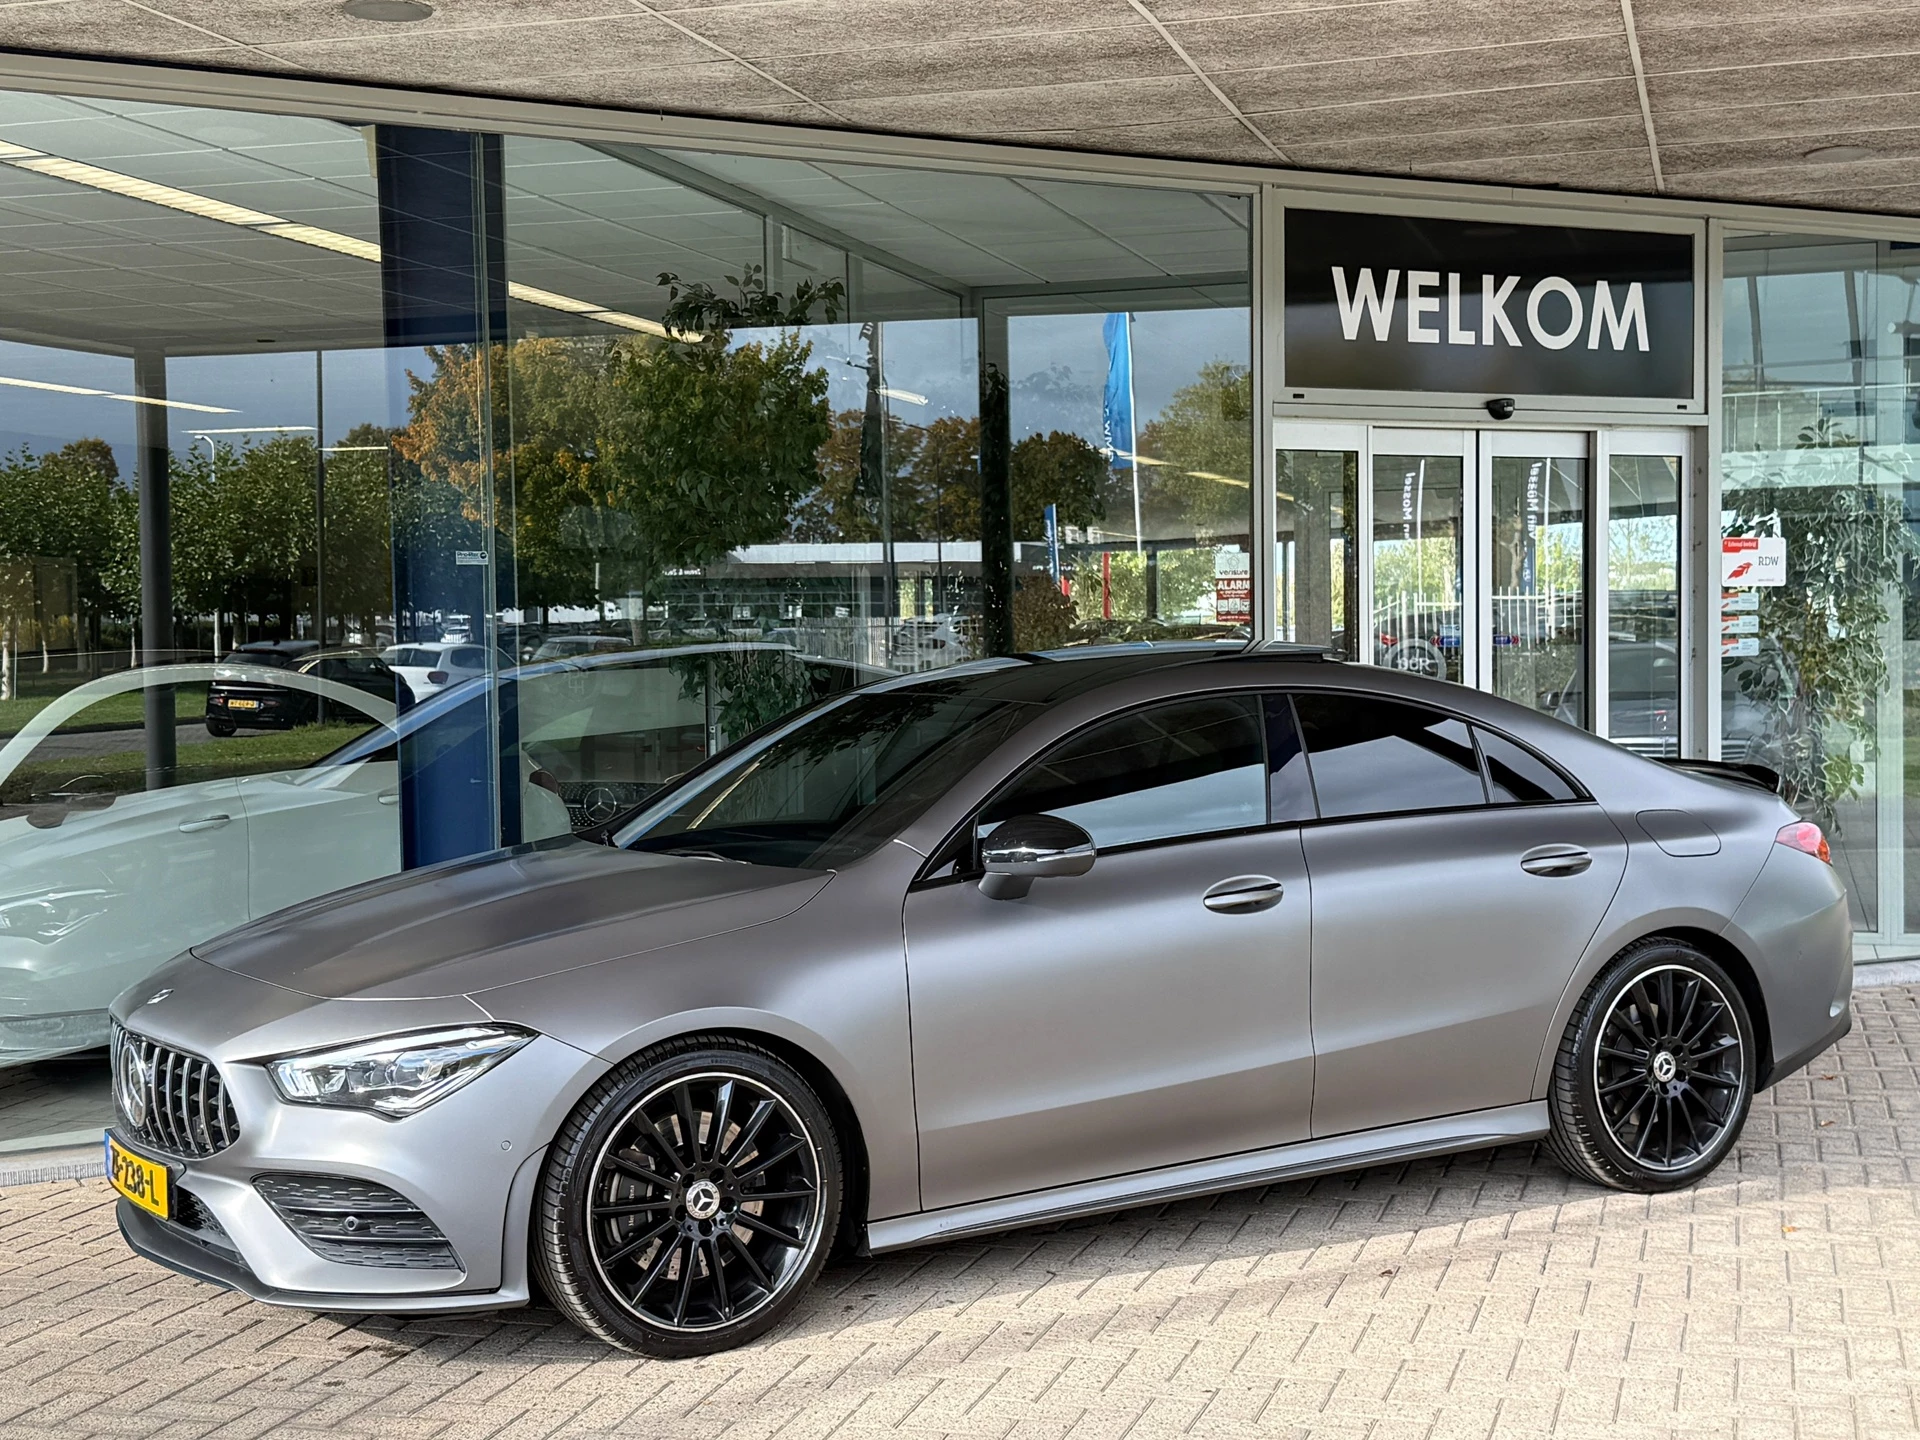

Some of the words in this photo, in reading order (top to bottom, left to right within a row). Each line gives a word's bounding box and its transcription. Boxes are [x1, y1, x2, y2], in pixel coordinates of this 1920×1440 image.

[1331, 266, 1650, 351] WELKOM
[1758, 556, 1779, 566] RDW
[1219, 569, 1248, 577] verisure
